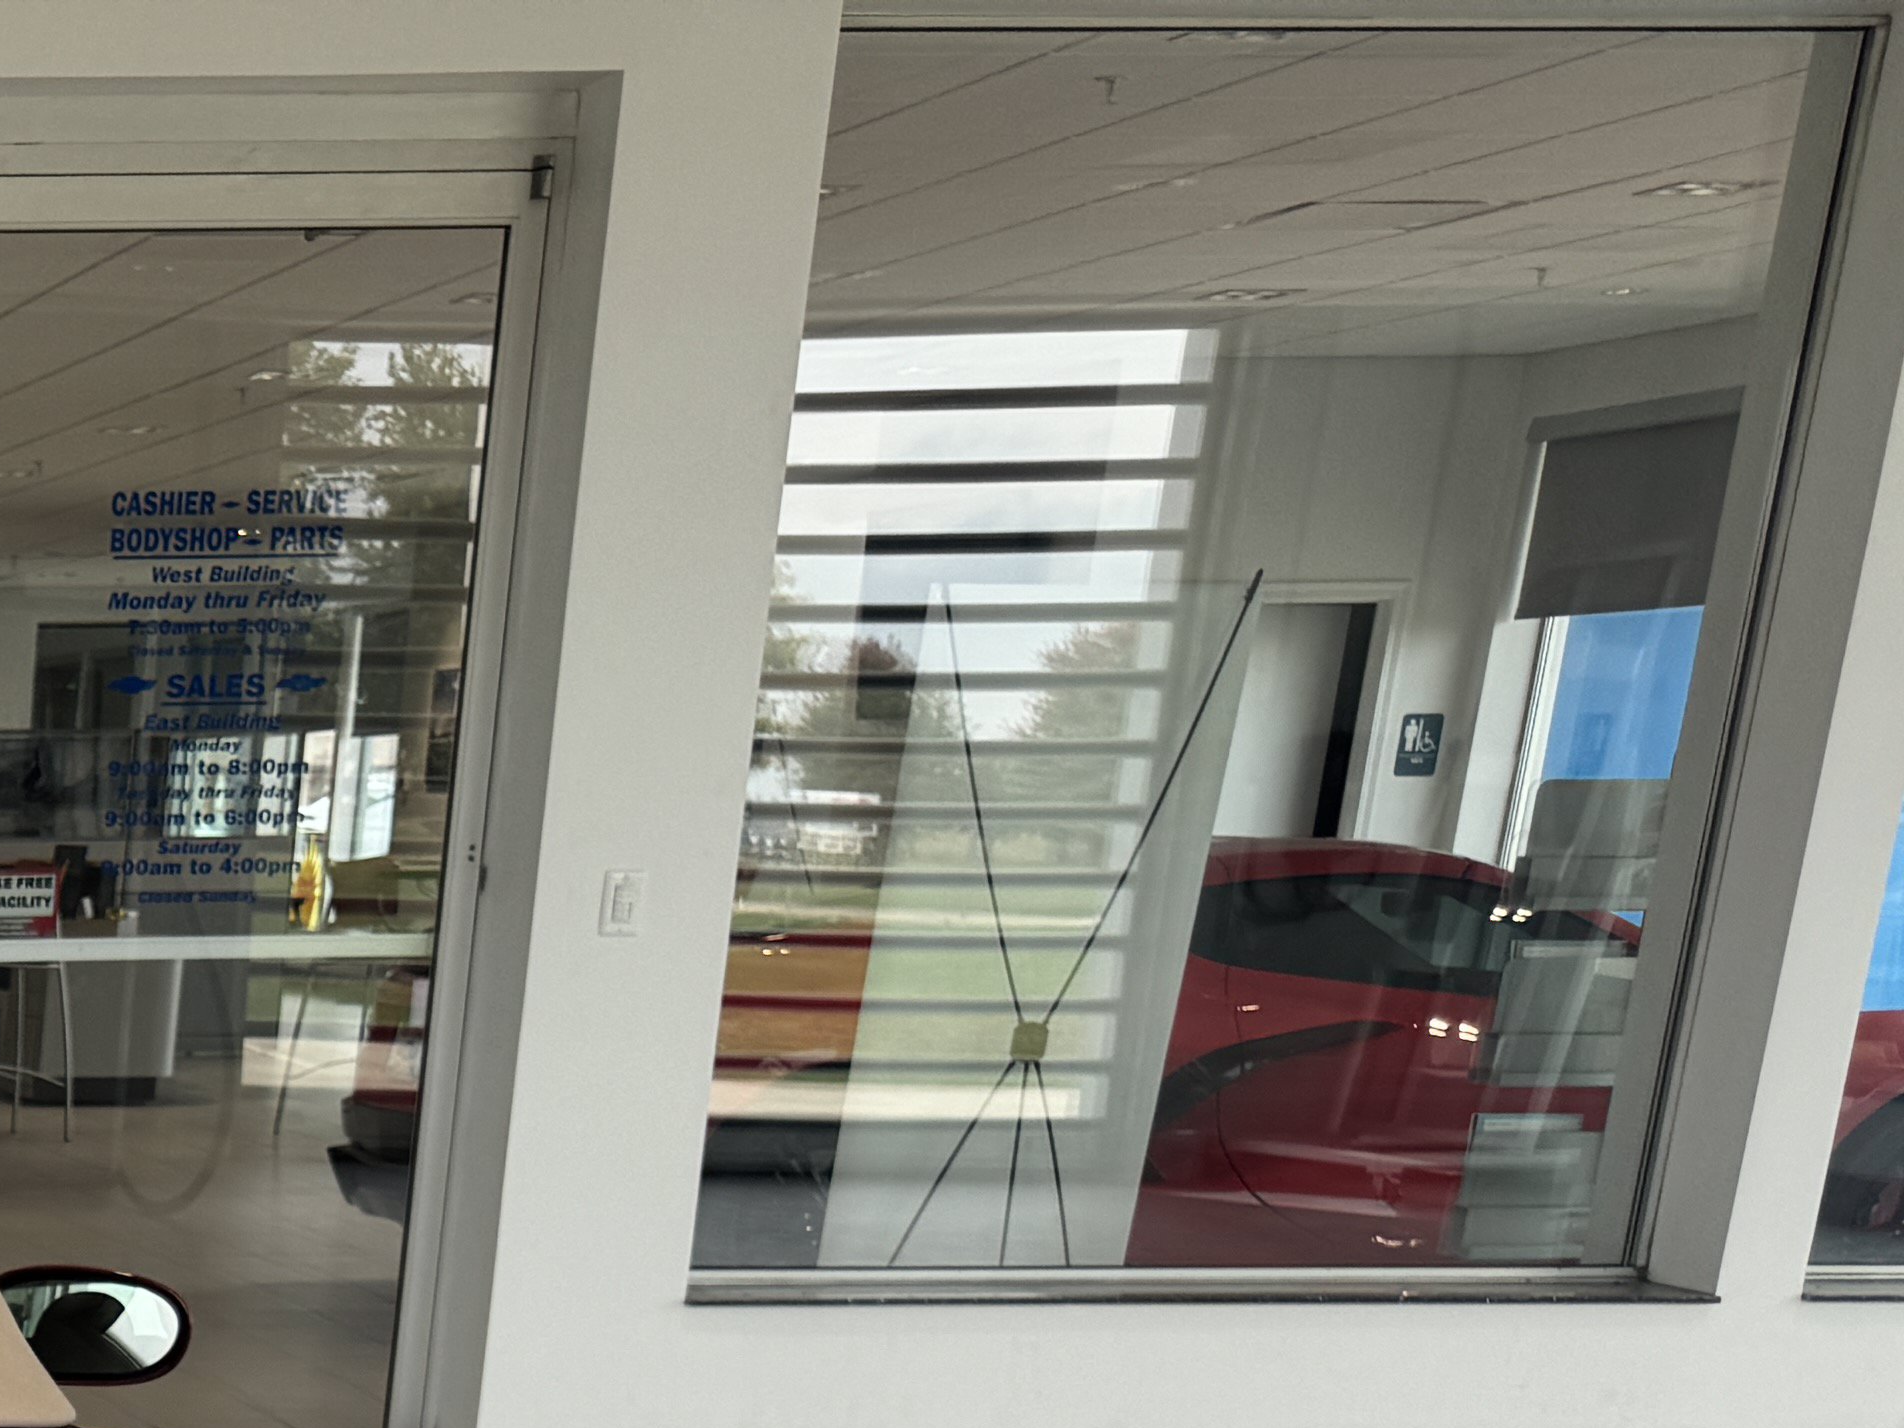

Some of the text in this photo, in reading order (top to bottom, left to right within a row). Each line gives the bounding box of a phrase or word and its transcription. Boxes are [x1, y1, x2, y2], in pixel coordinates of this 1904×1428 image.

[111, 489, 348, 516] CASHIER SERVICE
[110, 525, 344, 552] BODYSHOP PARTS
[152, 565, 296, 587] West Building
[108, 589, 327, 613] Monday thru Friday
[209, 619, 229, 634] to
[166, 673, 266, 699] SALES
[144, 713, 284, 732] East Building
[170, 738, 242, 754] Monday
[198, 760, 220, 776] to
[227, 759, 309, 777] 8:00pm
[198, 785, 237, 799] thru
[239, 785, 295, 801] Friday
[195, 810, 216, 826] to
[157, 840, 242, 855] Saturday
[190, 859, 212, 875] to
[219, 857, 302, 877] 4:00pm
[16, 877, 54, 889] FREE
